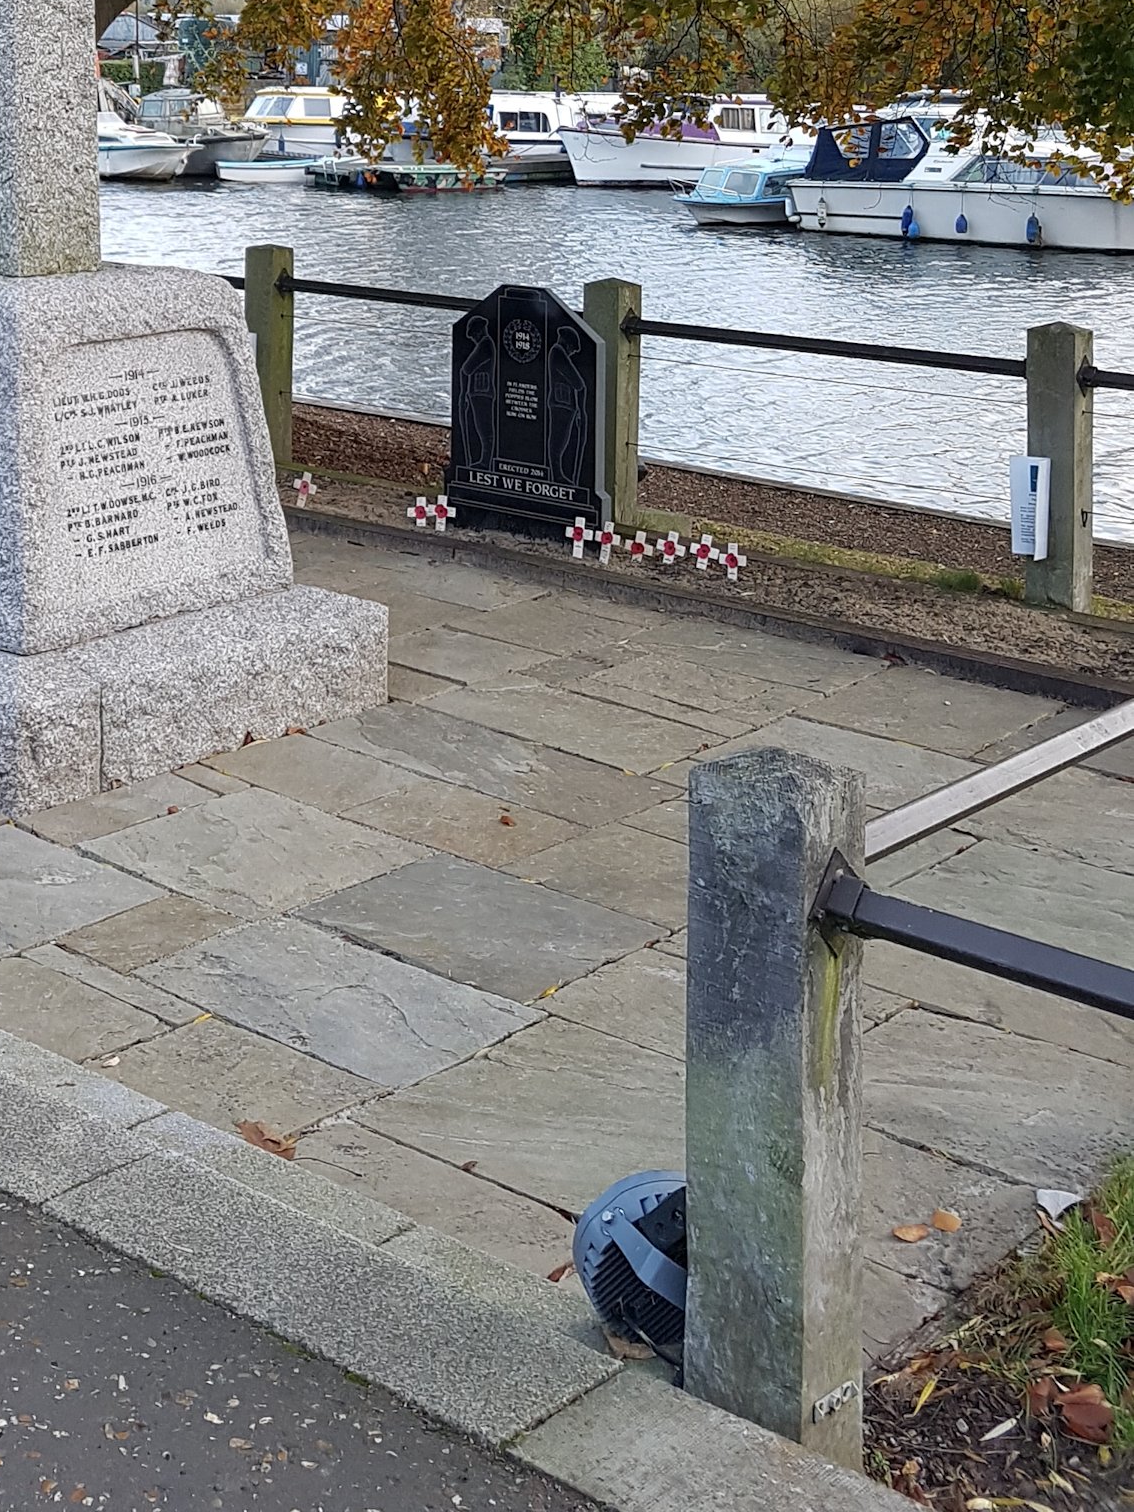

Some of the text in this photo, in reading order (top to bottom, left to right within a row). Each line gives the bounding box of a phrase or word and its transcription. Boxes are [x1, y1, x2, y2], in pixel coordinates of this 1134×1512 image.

[516, 332, 530, 340] 1914
[498, 463, 529, 474] ERECTED
[468, 470, 576, 500] LEST WE FORGET
